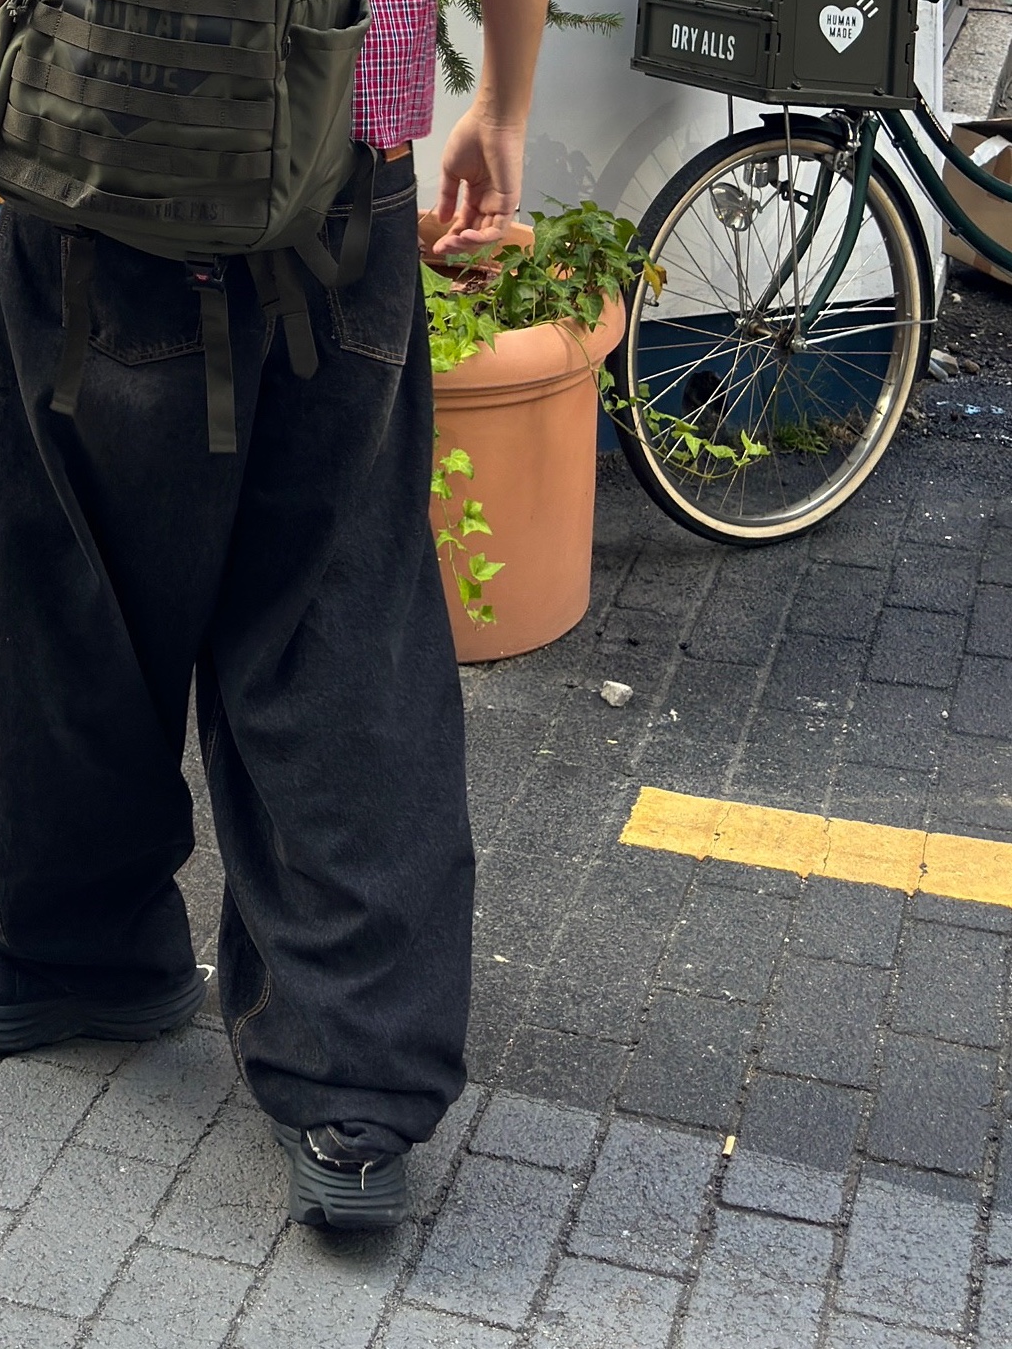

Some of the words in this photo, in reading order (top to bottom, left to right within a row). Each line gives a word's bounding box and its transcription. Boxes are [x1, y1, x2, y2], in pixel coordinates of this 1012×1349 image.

[826, 13, 857, 27] HUMAN
[829, 27, 853, 40] MADE
[671, 23, 699, 53] DRY
[701, 30, 736, 61] ALLS
